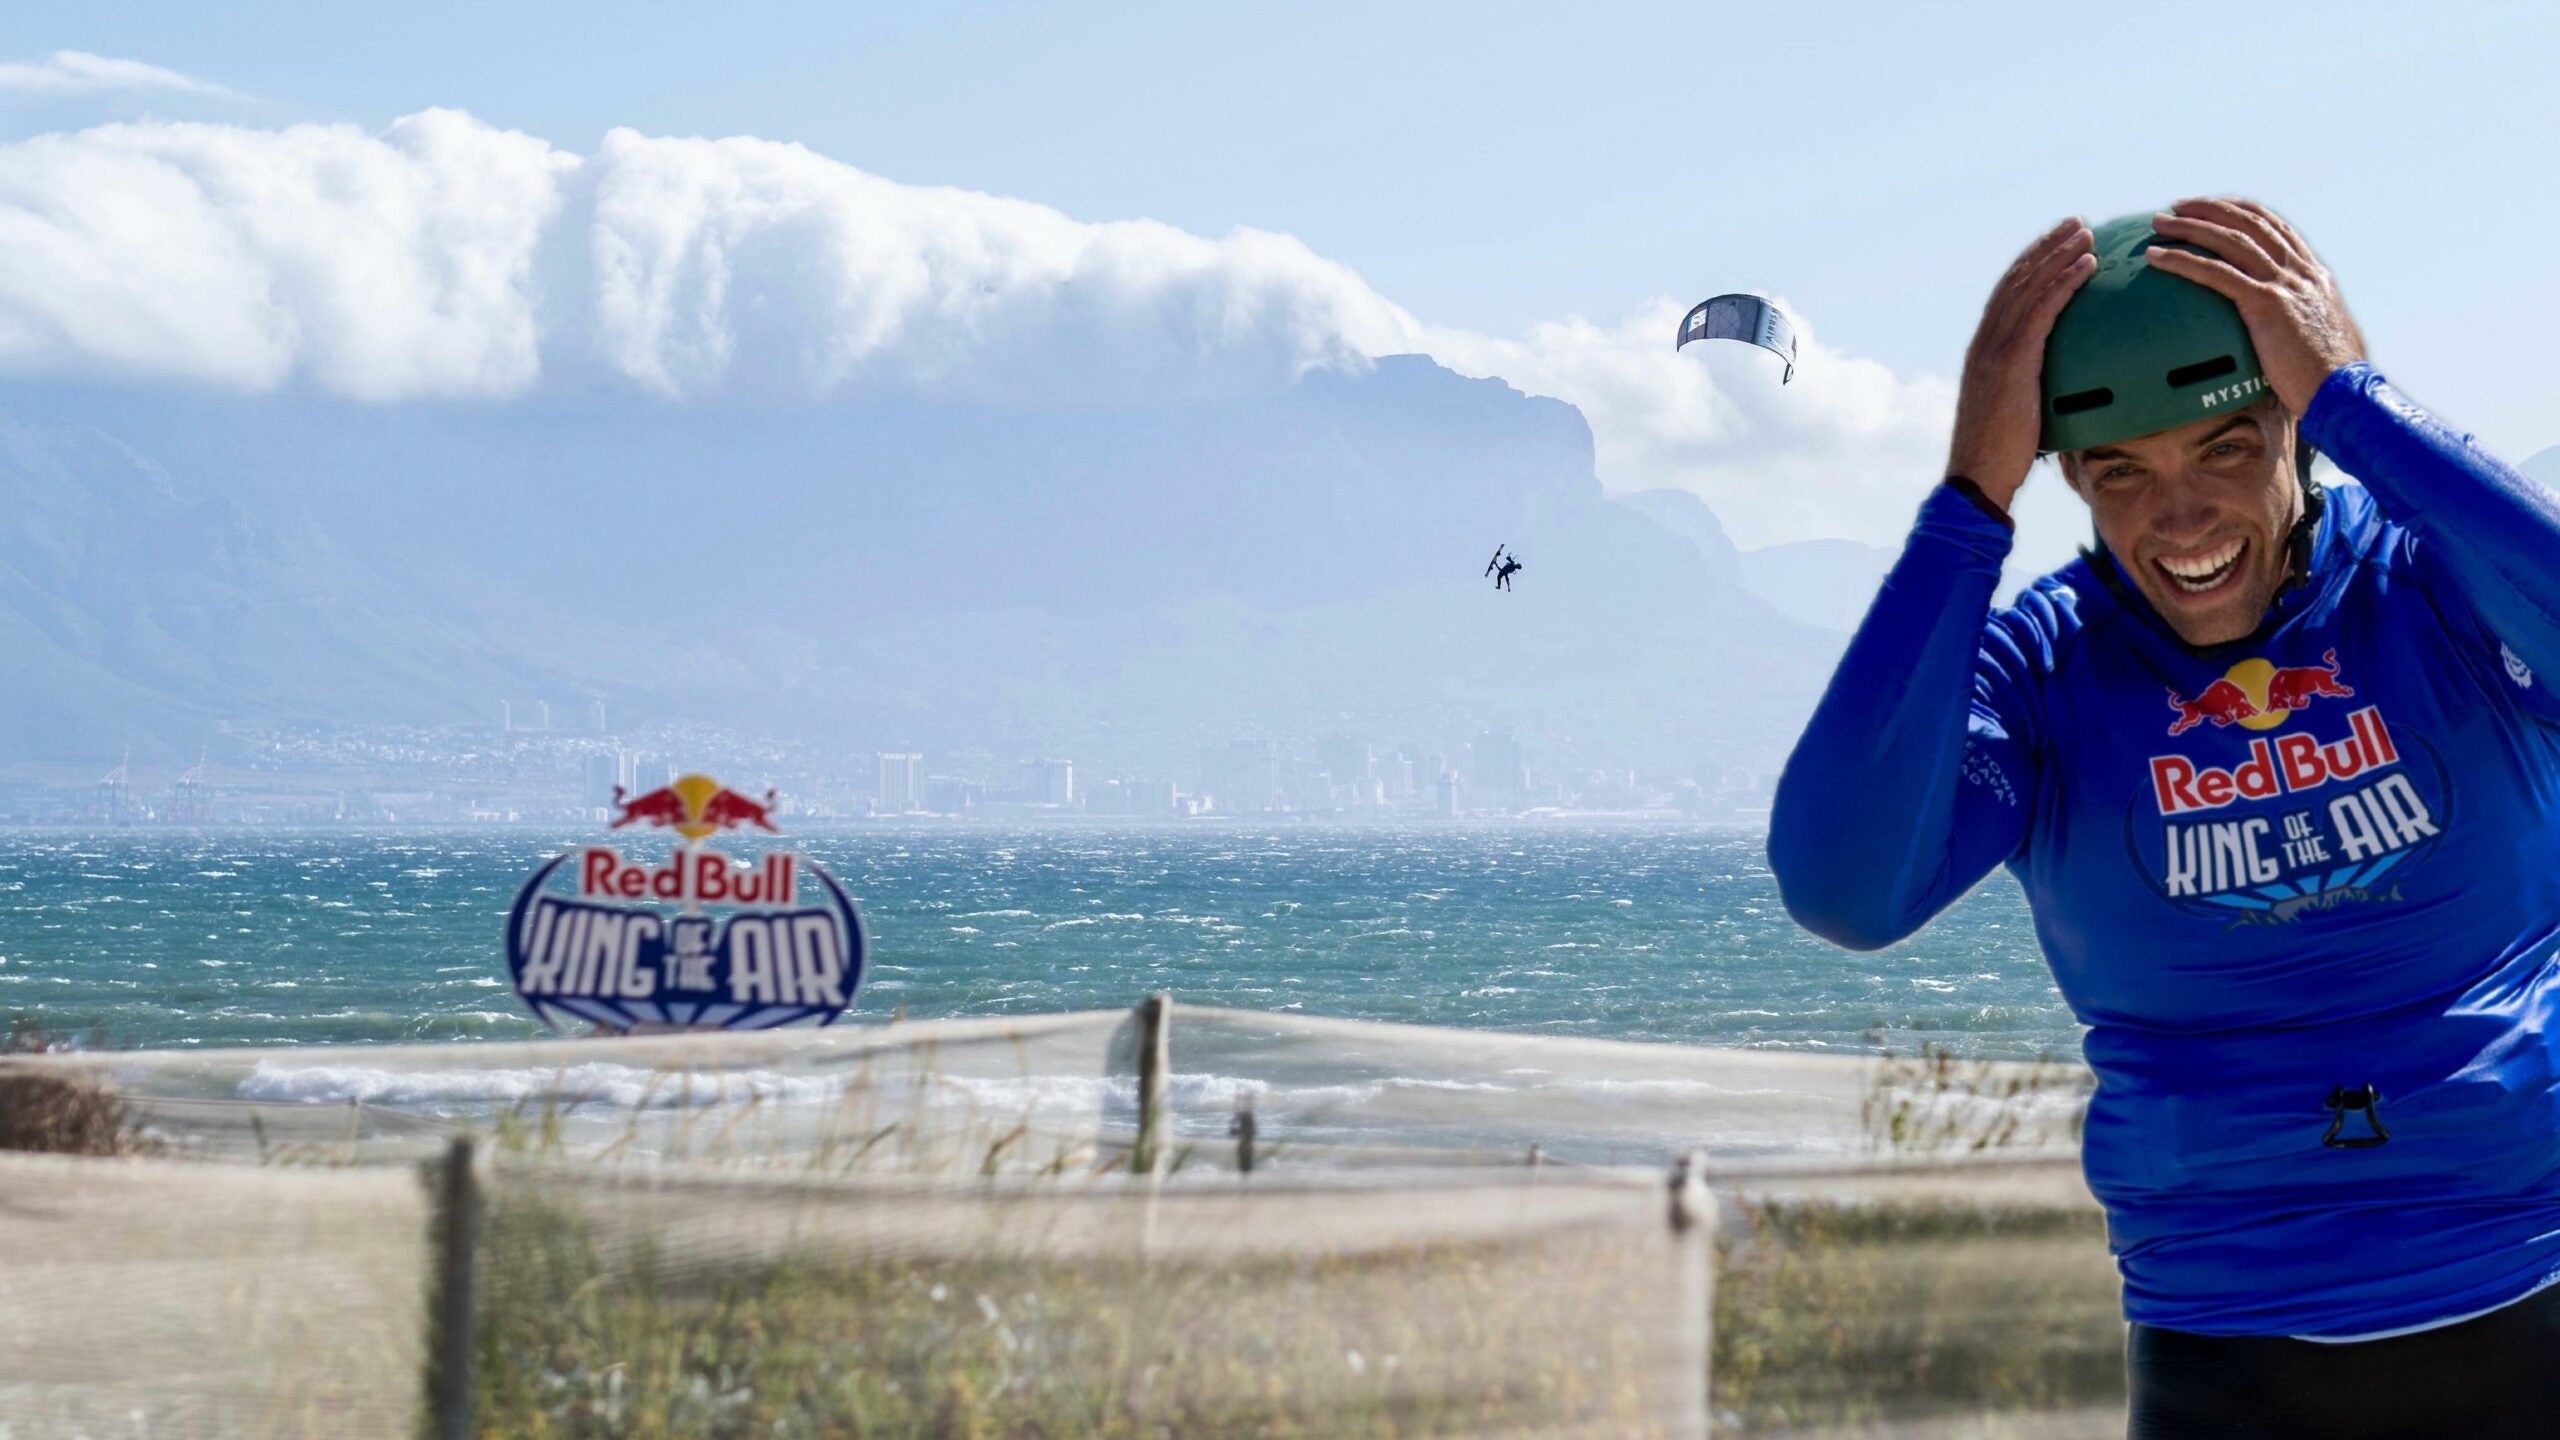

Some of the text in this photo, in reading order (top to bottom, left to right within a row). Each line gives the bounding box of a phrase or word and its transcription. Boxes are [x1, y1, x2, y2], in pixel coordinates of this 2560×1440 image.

[1982, 750, 2017, 807] TOWN
[2150, 704, 2399, 816] Red Bull
[584, 848, 793, 903] Red Bull
[2165, 773, 2441, 897] KING OF THE AIR
[519, 902, 847, 1007] KING OF THE AIR
